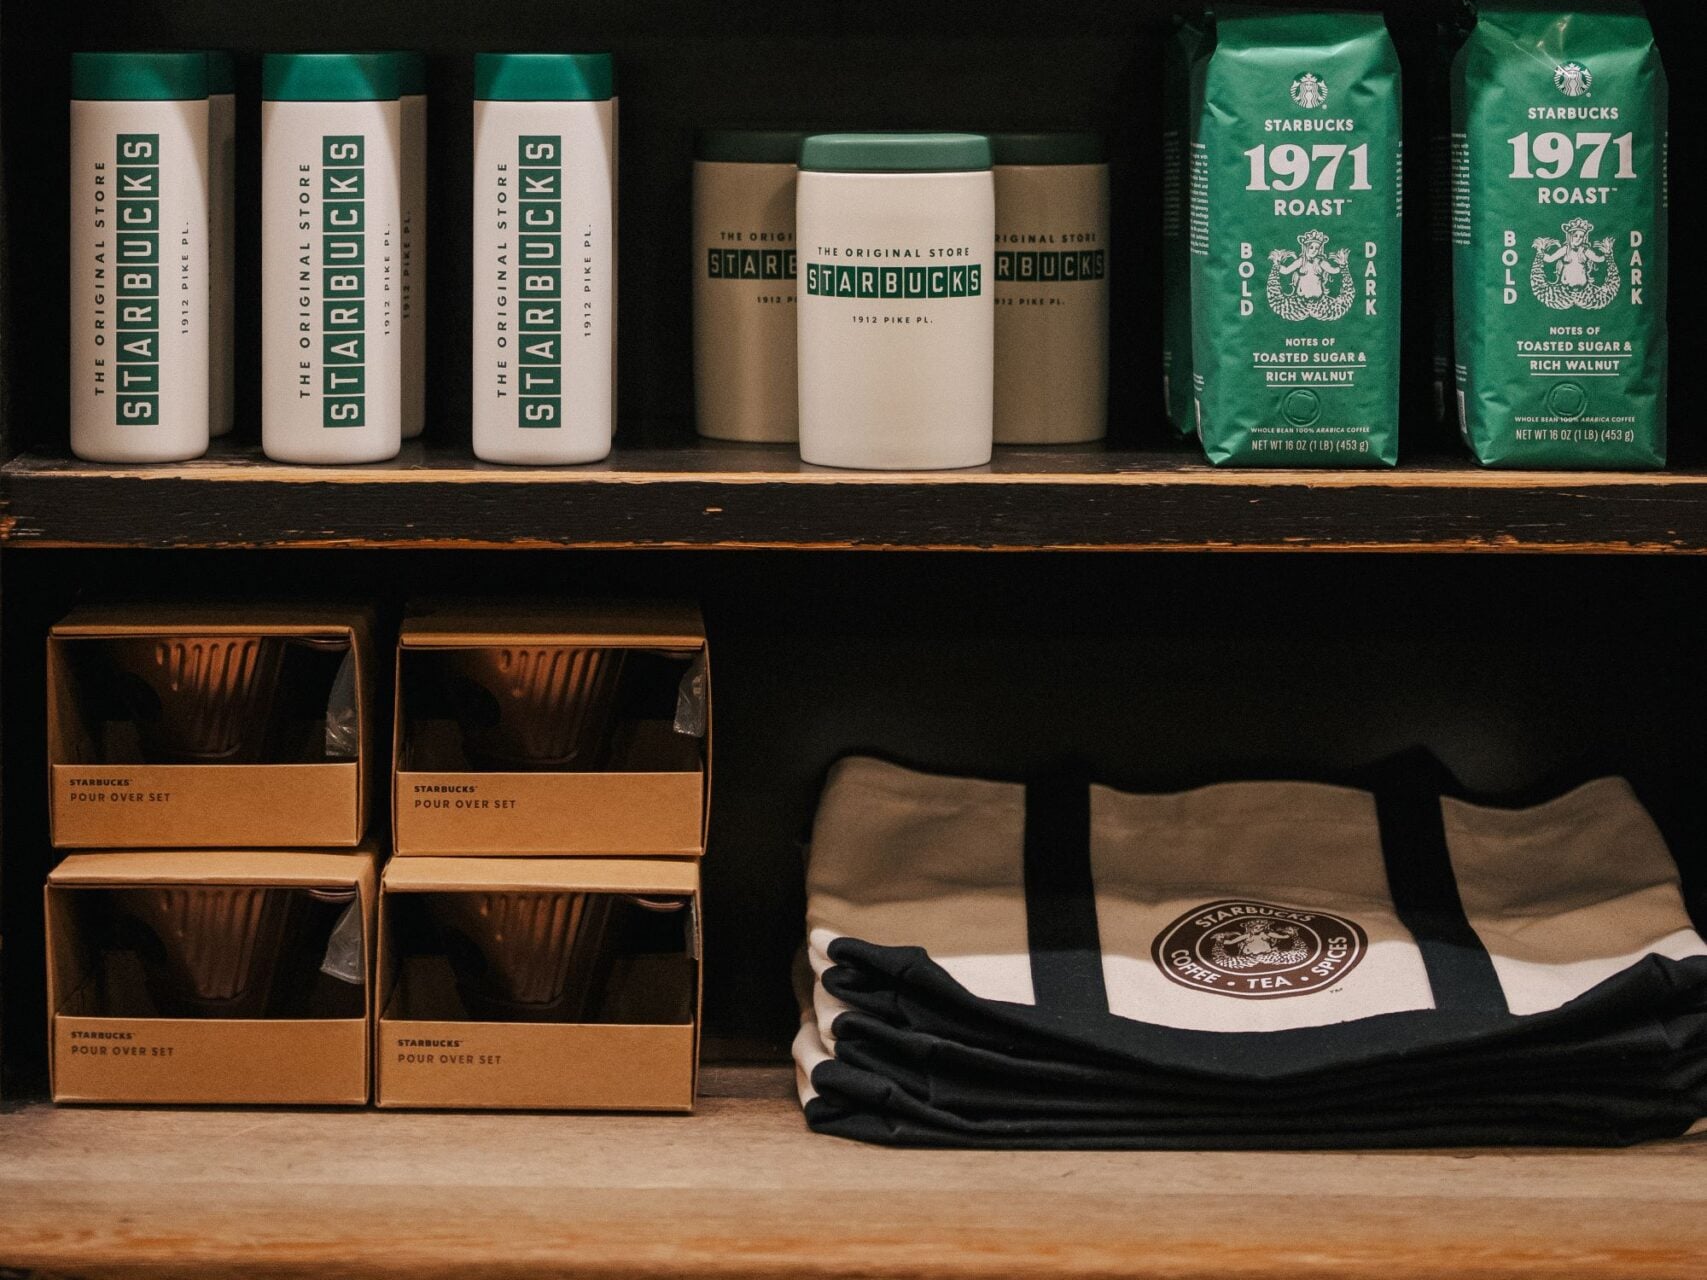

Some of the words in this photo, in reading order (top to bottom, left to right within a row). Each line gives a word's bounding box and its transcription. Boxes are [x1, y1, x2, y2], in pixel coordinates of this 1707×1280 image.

[1264, 119, 1353, 132] STARBUCKS
[1528, 107, 1618, 119] STARBUCKS
[1244, 143, 1372, 191] 1971
[1507, 132, 1637, 179] 1971
[95, 163, 105, 228] STORE
[299, 165, 310, 230] STORE
[497, 164, 507, 229] STORE
[818, 247, 838, 256] THE
[845, 248, 920, 258] ORIGINAL
[929, 247, 969, 258] STORE
[1502, 230, 1518, 304] BOLD
[1630, 231, 1642, 305] DARK
[124, 142, 152, 418] STARBUCKS
[181, 255, 189, 290] PIKE
[331, 143, 358, 420] STARBUCKS
[526, 143, 555, 420] STARBUCKS
[809, 268, 978, 293] STARBUCKS
[1238, 242, 1254, 316] BOLD
[1365, 241, 1377, 315] DARK
[95, 241, 105, 346] ORIGINAL
[299, 243, 310, 349] ORIGINAL
[497, 243, 507, 348] ORIGINAL
[181, 299, 189, 334] 1912
[884, 316, 910, 324] PIKE
[1550, 326, 1583, 335] NOTES
[1586, 327, 1600, 335] OF
[1253, 352, 1309, 363] TOASTED
[1313, 352, 1355, 362] SUGAR
[1358, 352, 1366, 362] &
[1285, 338, 1318, 346] NOTES
[1322, 338, 1335, 346] OF
[1517, 341, 1573, 351] TOASTED
[1578, 341, 1620, 351] SUGAR
[1623, 341, 1632, 351] &
[95, 359, 104, 396] THE
[300, 362, 310, 399] THE
[497, 361, 507, 398] THE
[1266, 371, 1296, 381] RICH
[1301, 371, 1354, 381] WALNUT
[1530, 360, 1561, 370] RICH
[1565, 360, 1620, 370] WALNUT
[70, 792, 105, 802] POUR
[110, 792, 144, 802] OVER
[149, 792, 170, 802] SET
[415, 799, 450, 808] POUR
[455, 799, 489, 809] OVER
[494, 800, 516, 809] SET
[1195, 906, 1316, 928] STARBUCKS
[1171, 949, 1221, 984] COFFEE
[1247, 976, 1293, 989] TEA
[1311, 937, 1347, 977] SPICES
[71, 1045, 107, 1055] POUR
[112, 1046, 147, 1056] OVER
[151, 1047, 174, 1057] SET
[398, 1054, 434, 1064] POUR
[439, 1054, 474, 1064] OVER
[479, 1055, 501, 1065] SET
